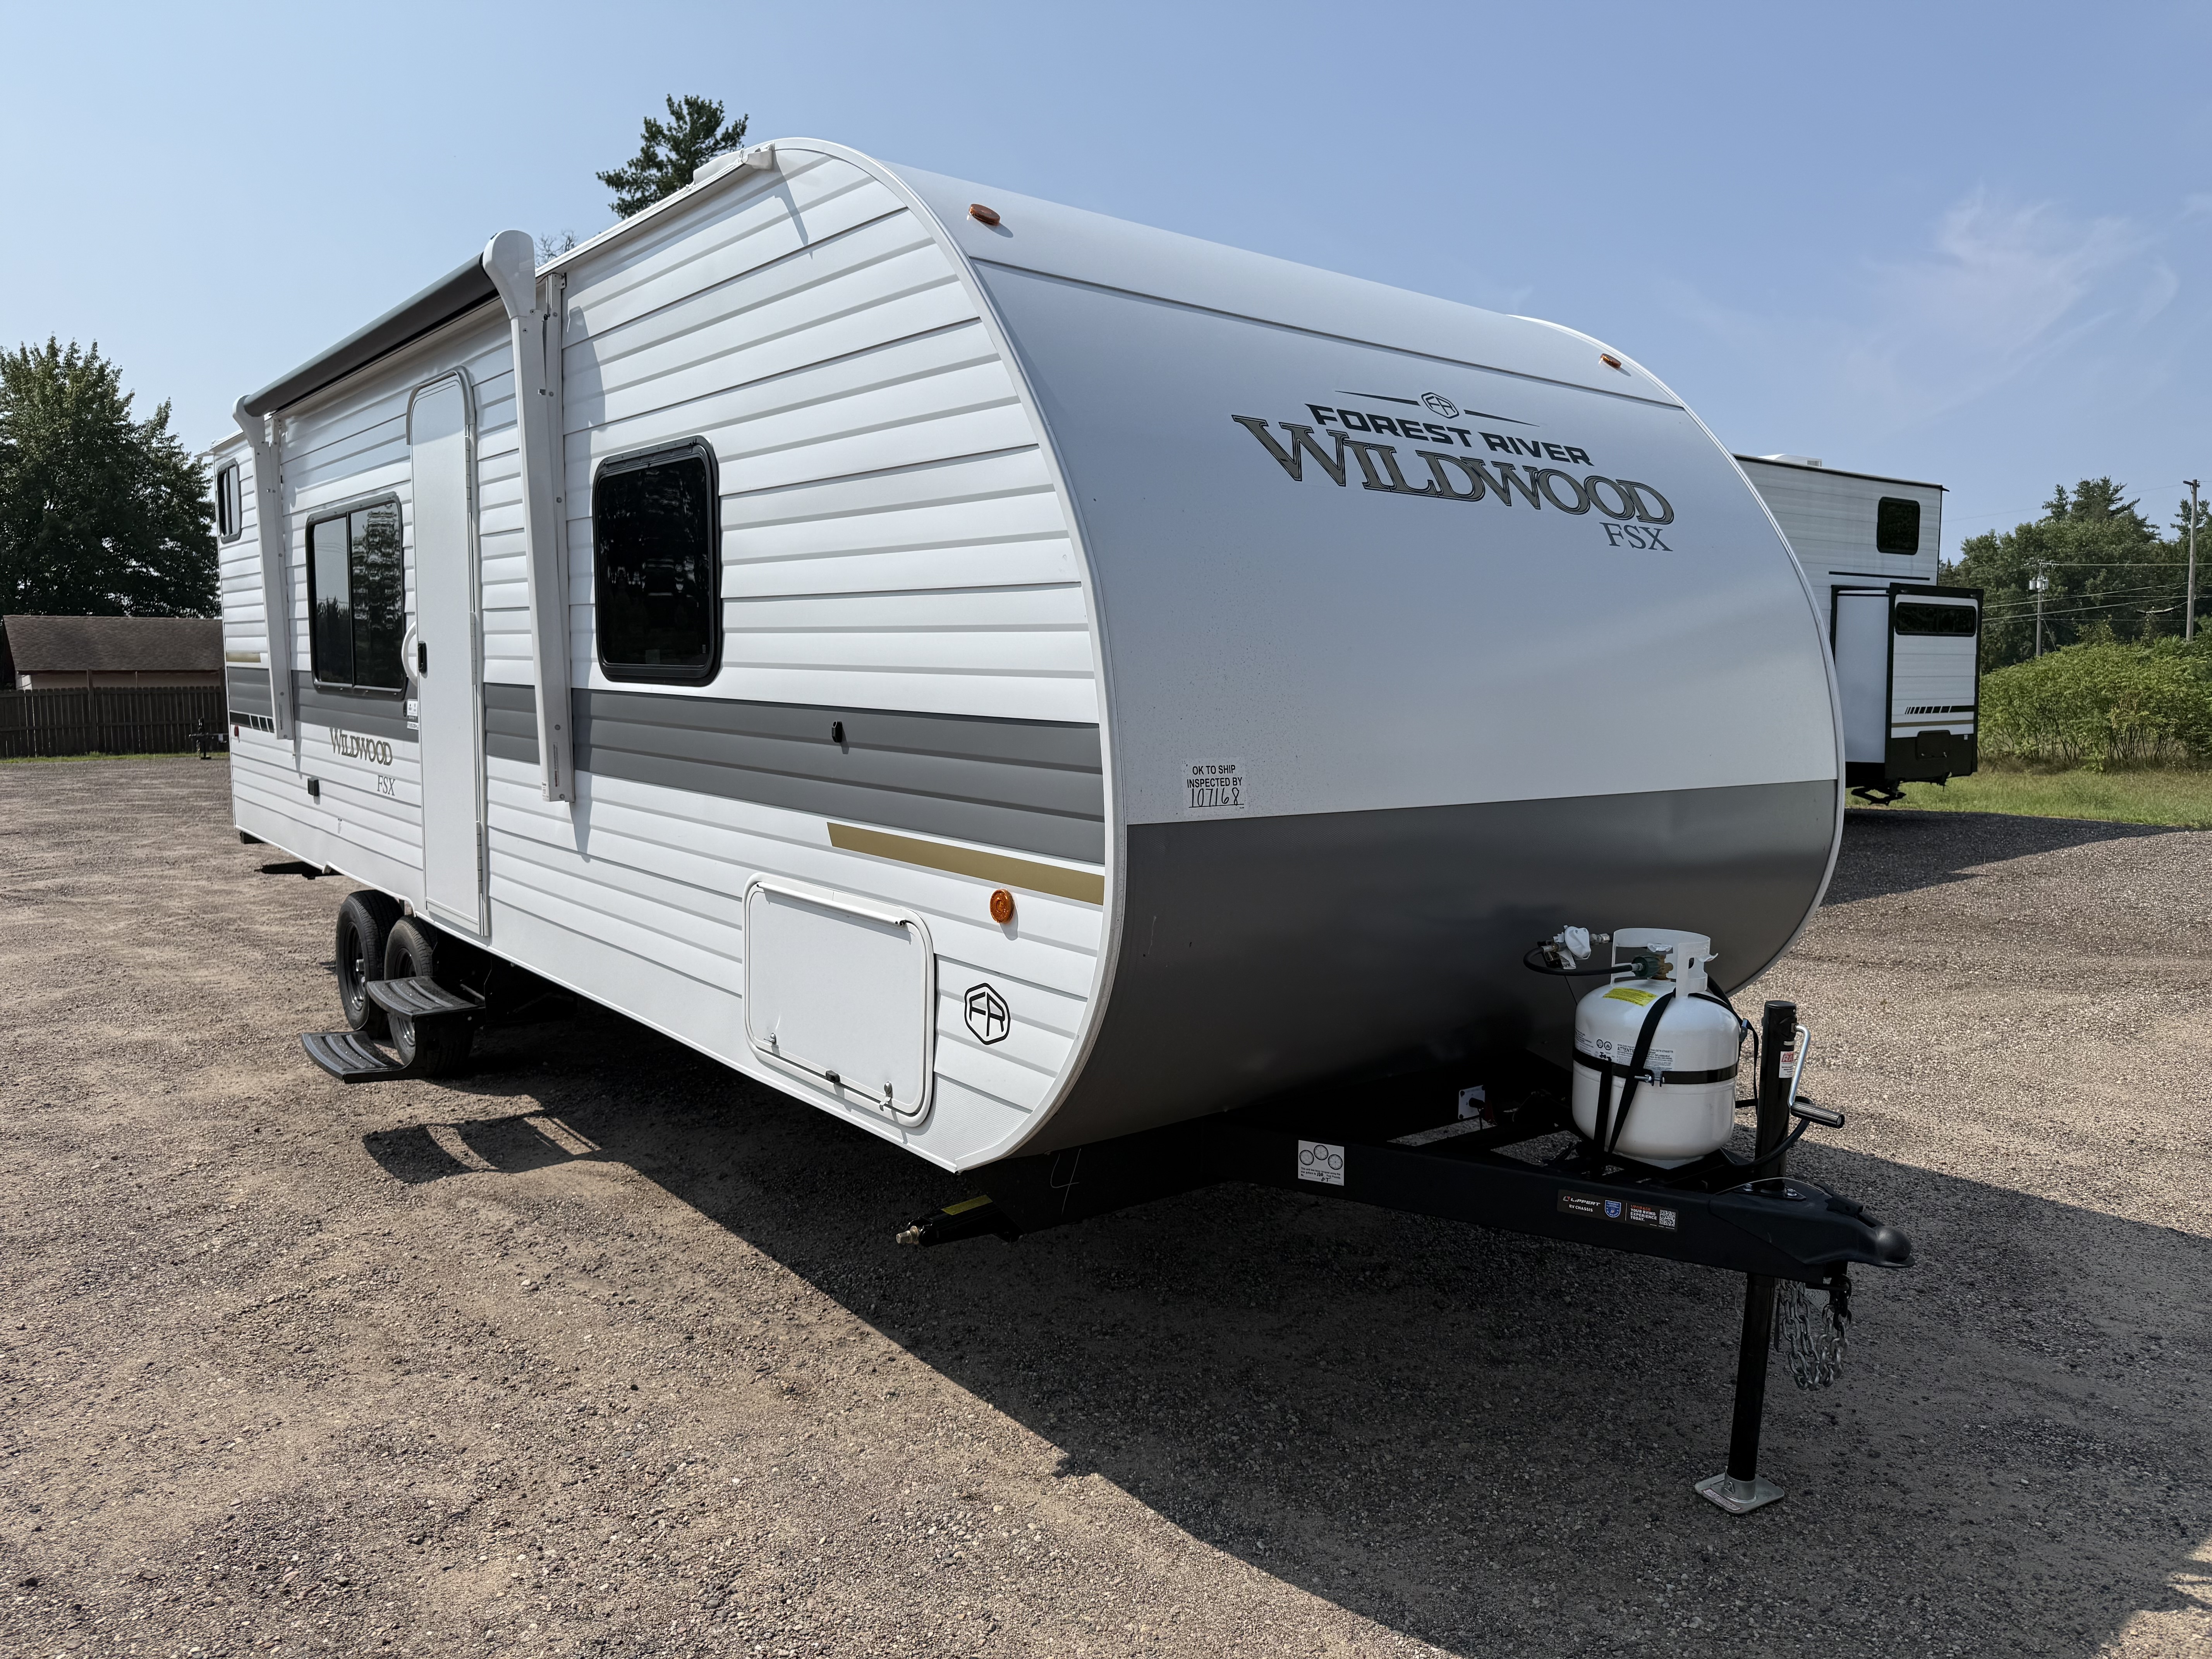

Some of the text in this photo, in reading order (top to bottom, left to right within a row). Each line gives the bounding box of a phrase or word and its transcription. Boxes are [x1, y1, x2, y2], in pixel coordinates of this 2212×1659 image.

[1304, 404, 1594, 466] FOREST RIVER
[1231, 414, 1675, 525] WILDWOOD
[1599, 522, 1673, 551] FSX
[329, 727, 393, 766] WILDWOOD
[1187, 777, 1242, 788] INSPECTED BY
[1192, 764, 1235, 775] OK TO SHIP
[377, 775, 396, 796] FSX
[969, 991, 1006, 1037] FR
[1630, 1211, 1657, 1220] EXPERIENCE
